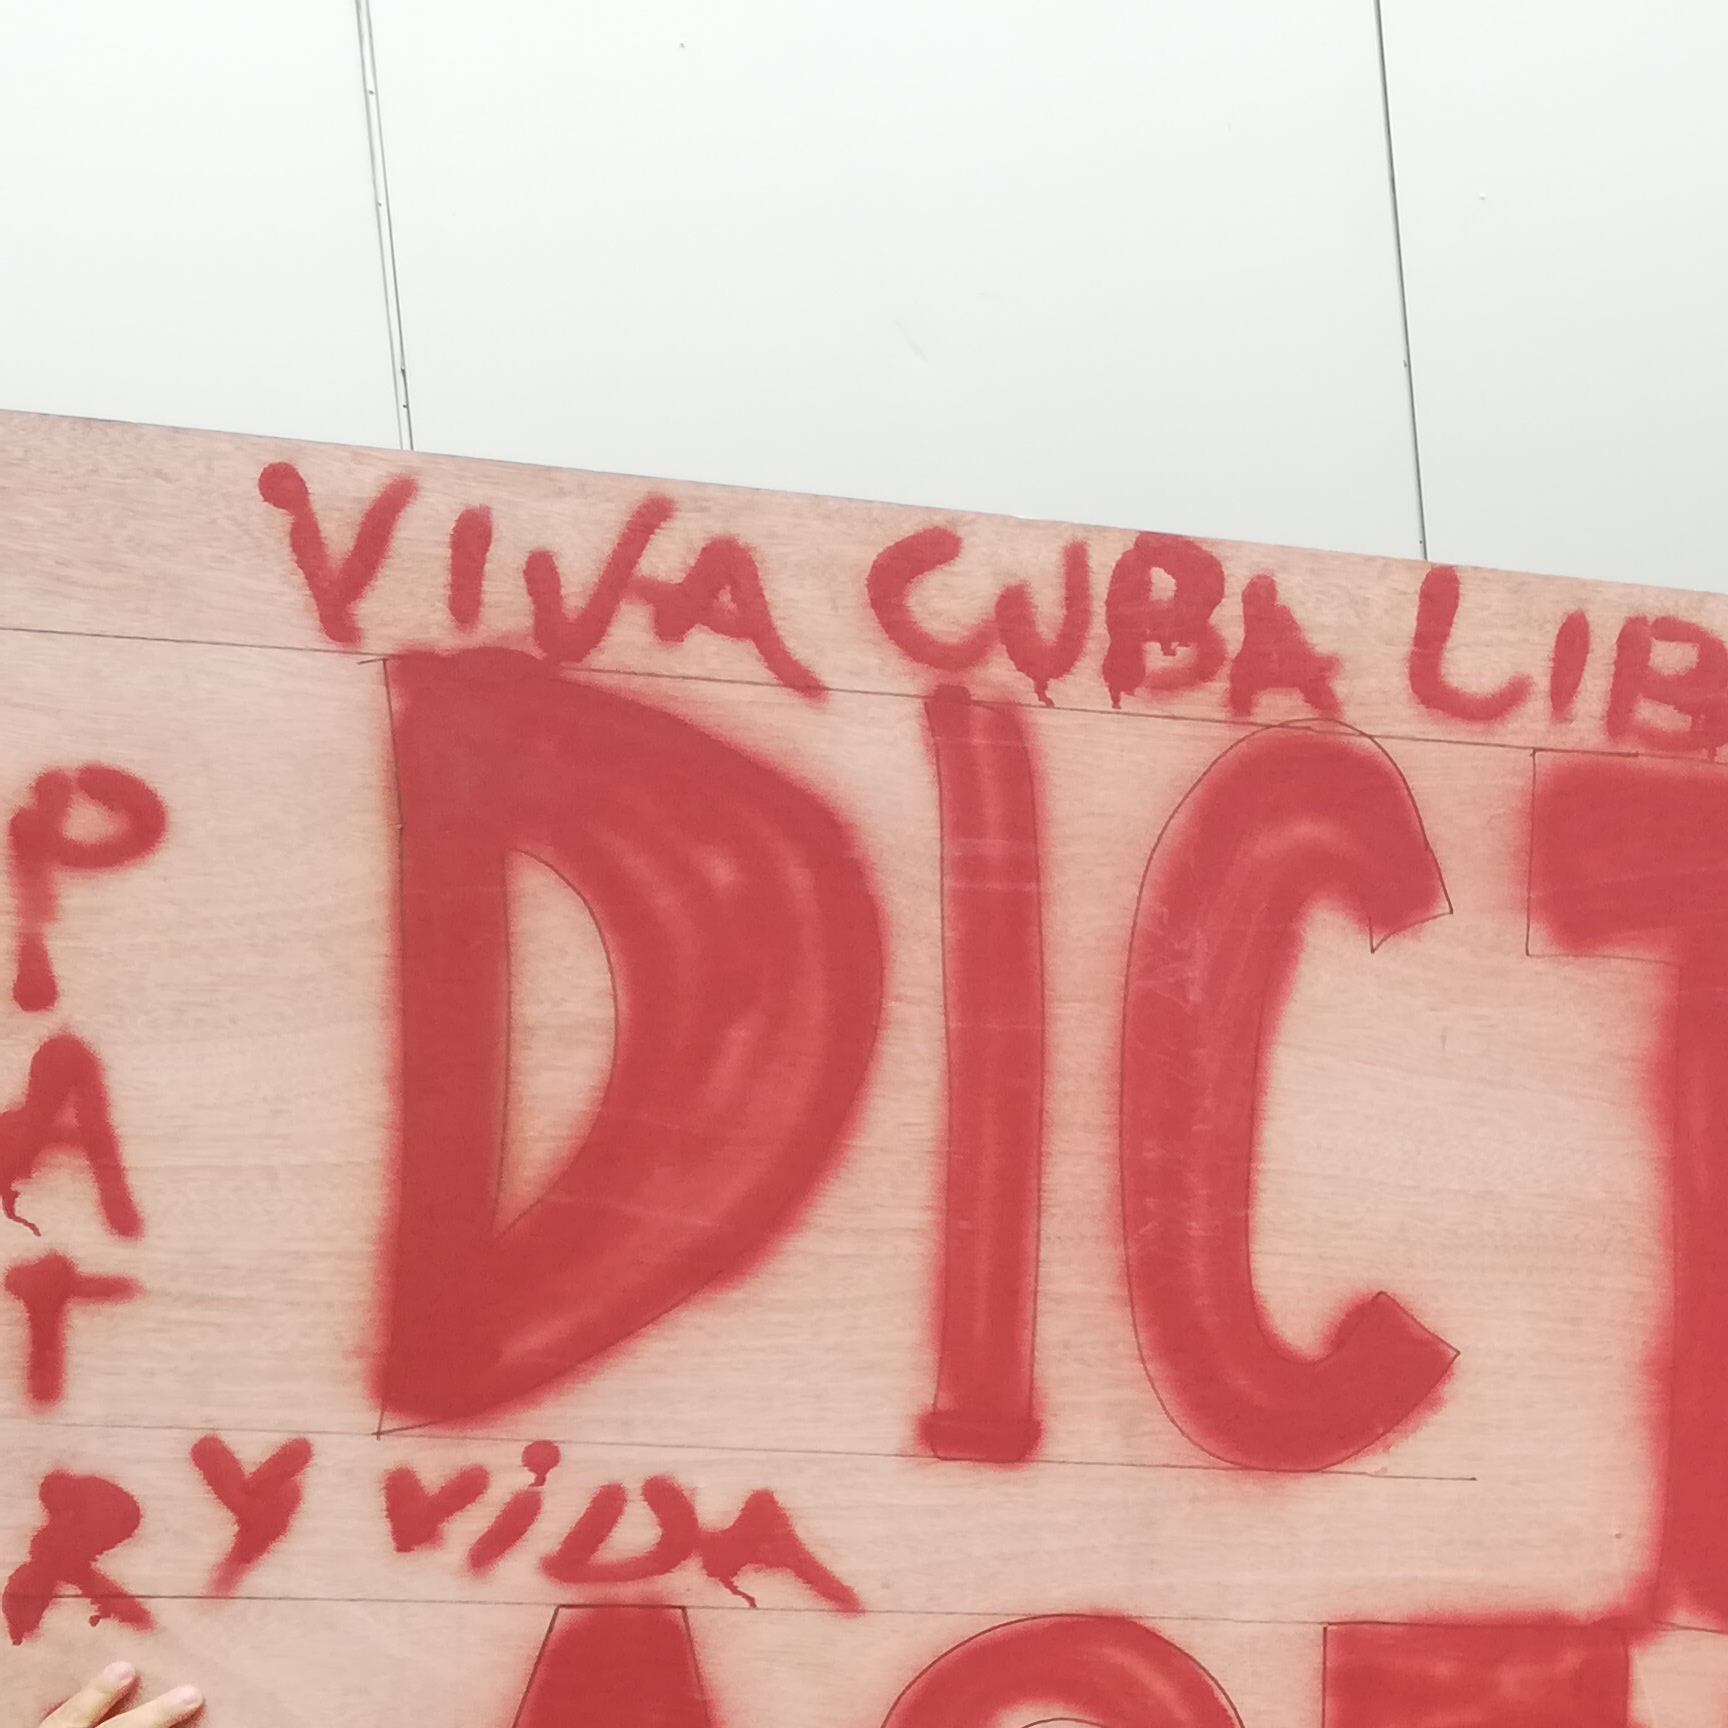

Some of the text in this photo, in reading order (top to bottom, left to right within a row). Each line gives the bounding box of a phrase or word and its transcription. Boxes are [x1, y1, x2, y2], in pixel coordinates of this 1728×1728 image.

[258, 462, 828, 702] VIVA
[865, 526, 1345, 714] CUBA
[191, 1436, 313, 1595] Y
